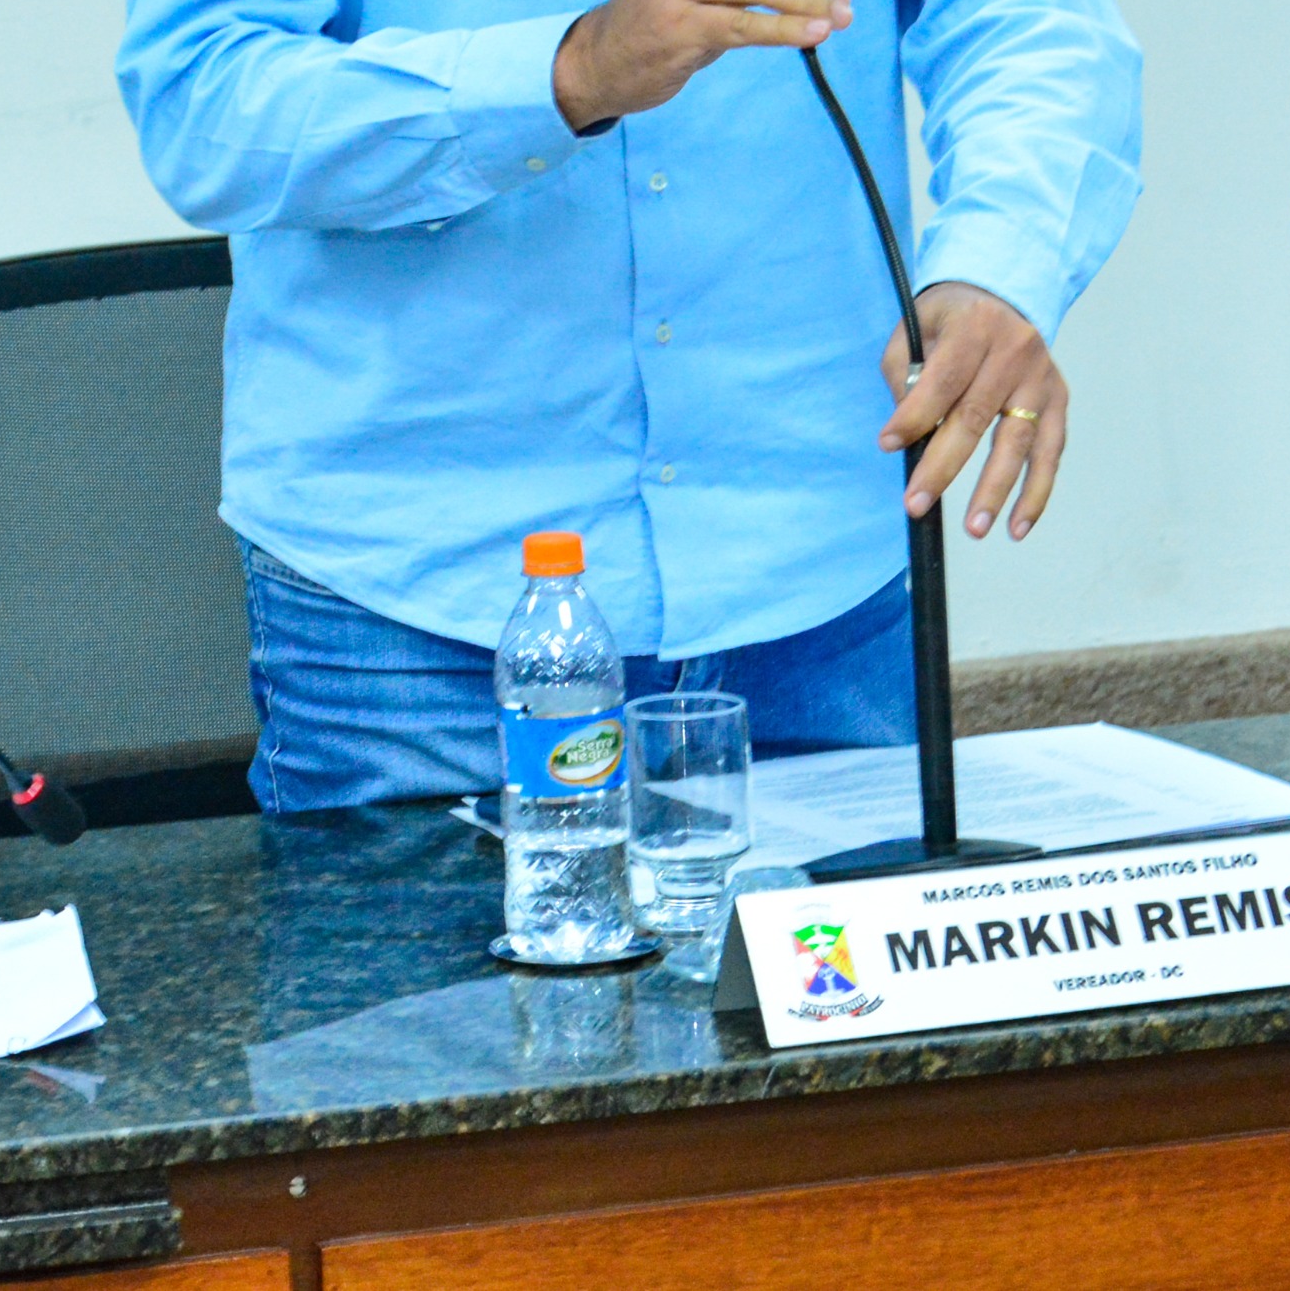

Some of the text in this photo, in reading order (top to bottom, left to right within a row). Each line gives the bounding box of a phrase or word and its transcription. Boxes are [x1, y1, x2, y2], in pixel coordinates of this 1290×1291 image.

[566, 748, 610, 764] Negra
[577, 737, 614, 752] Serra
[922, 852, 1259, 905] MARCOS REMIS DOS SANTOS FILHO
[885, 906, 1121, 974] MARKIN
[1053, 969, 1146, 992] VEREADOR
[1160, 964, 1184, 980] DC
